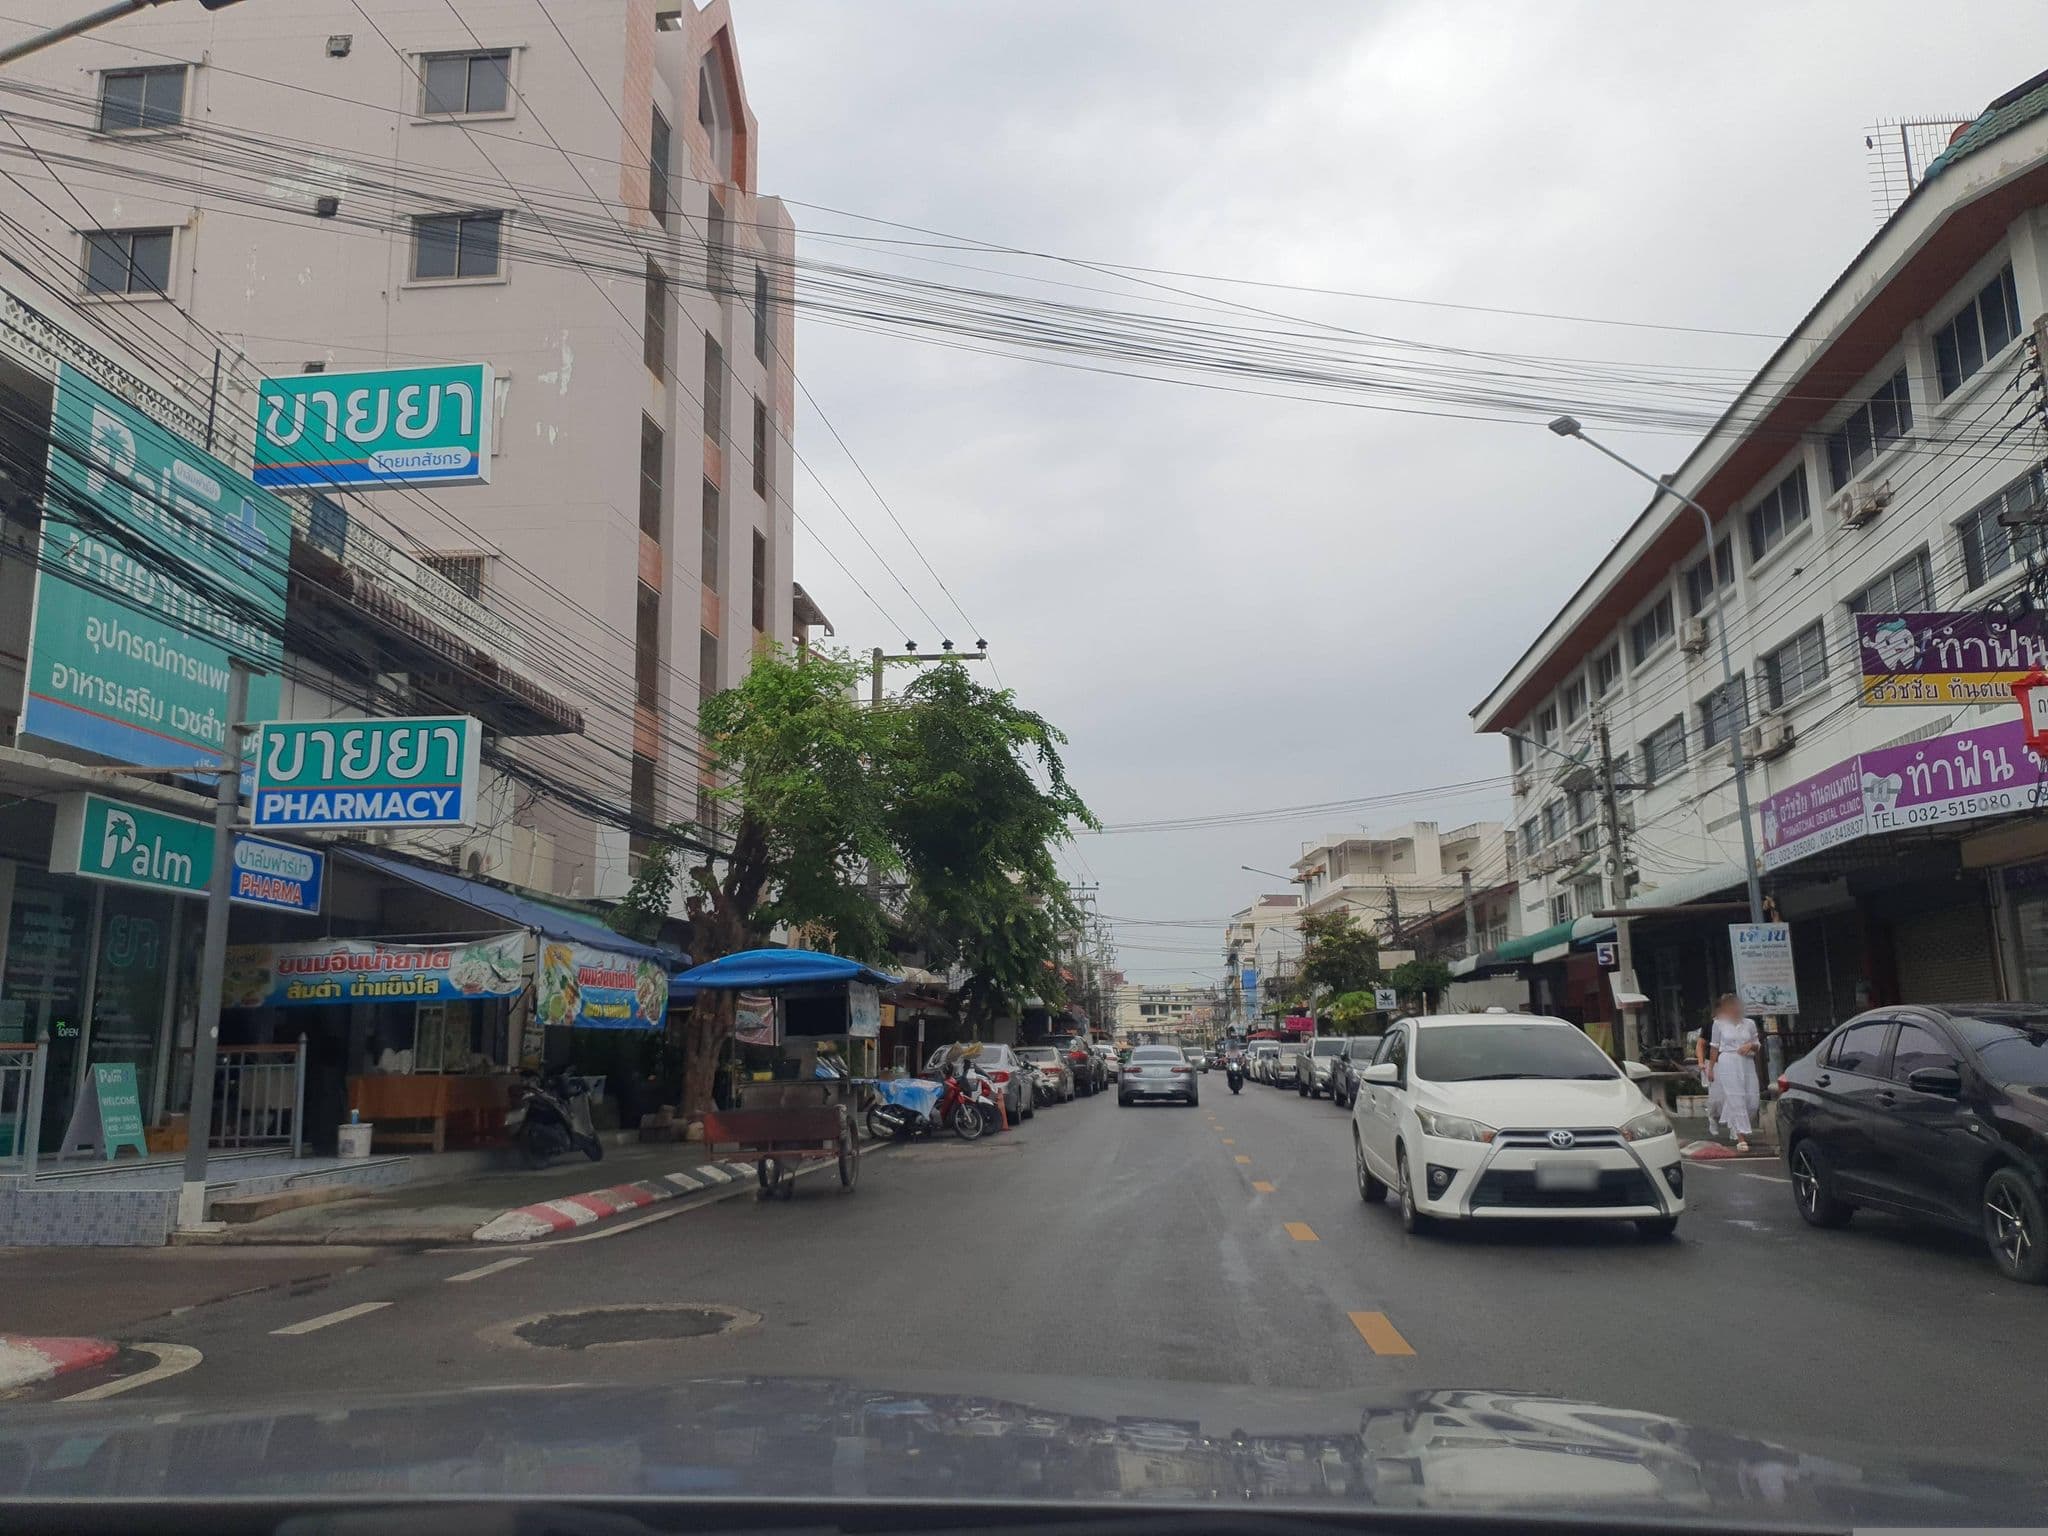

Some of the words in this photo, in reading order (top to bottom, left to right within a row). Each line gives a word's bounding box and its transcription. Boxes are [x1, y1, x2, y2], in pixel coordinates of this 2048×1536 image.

[265, 381, 474, 447] ขายยา
[87, 403, 214, 552] Palm
[377, 452, 462, 468] โดยเภสัชกร
[52, 662, 164, 722] อาหารเสริม
[268, 727, 458, 781] ขายยา
[1907, 740, 2014, 797] ทำฟัน
[262, 790, 454, 821] PHARMACY
[1816, 807, 1838, 826] DENTAL
[1839, 796, 1862, 816] CLINIC
[1872, 812, 1904, 829] TEL.
[1909, 793, 2011, 824] 032-515080
[101, 808, 192, 884] Palm
[239, 872, 303, 906] PHARMA
[1599, 947, 1613, 964] 5
[103, 1096, 137, 1105] WELCOME
